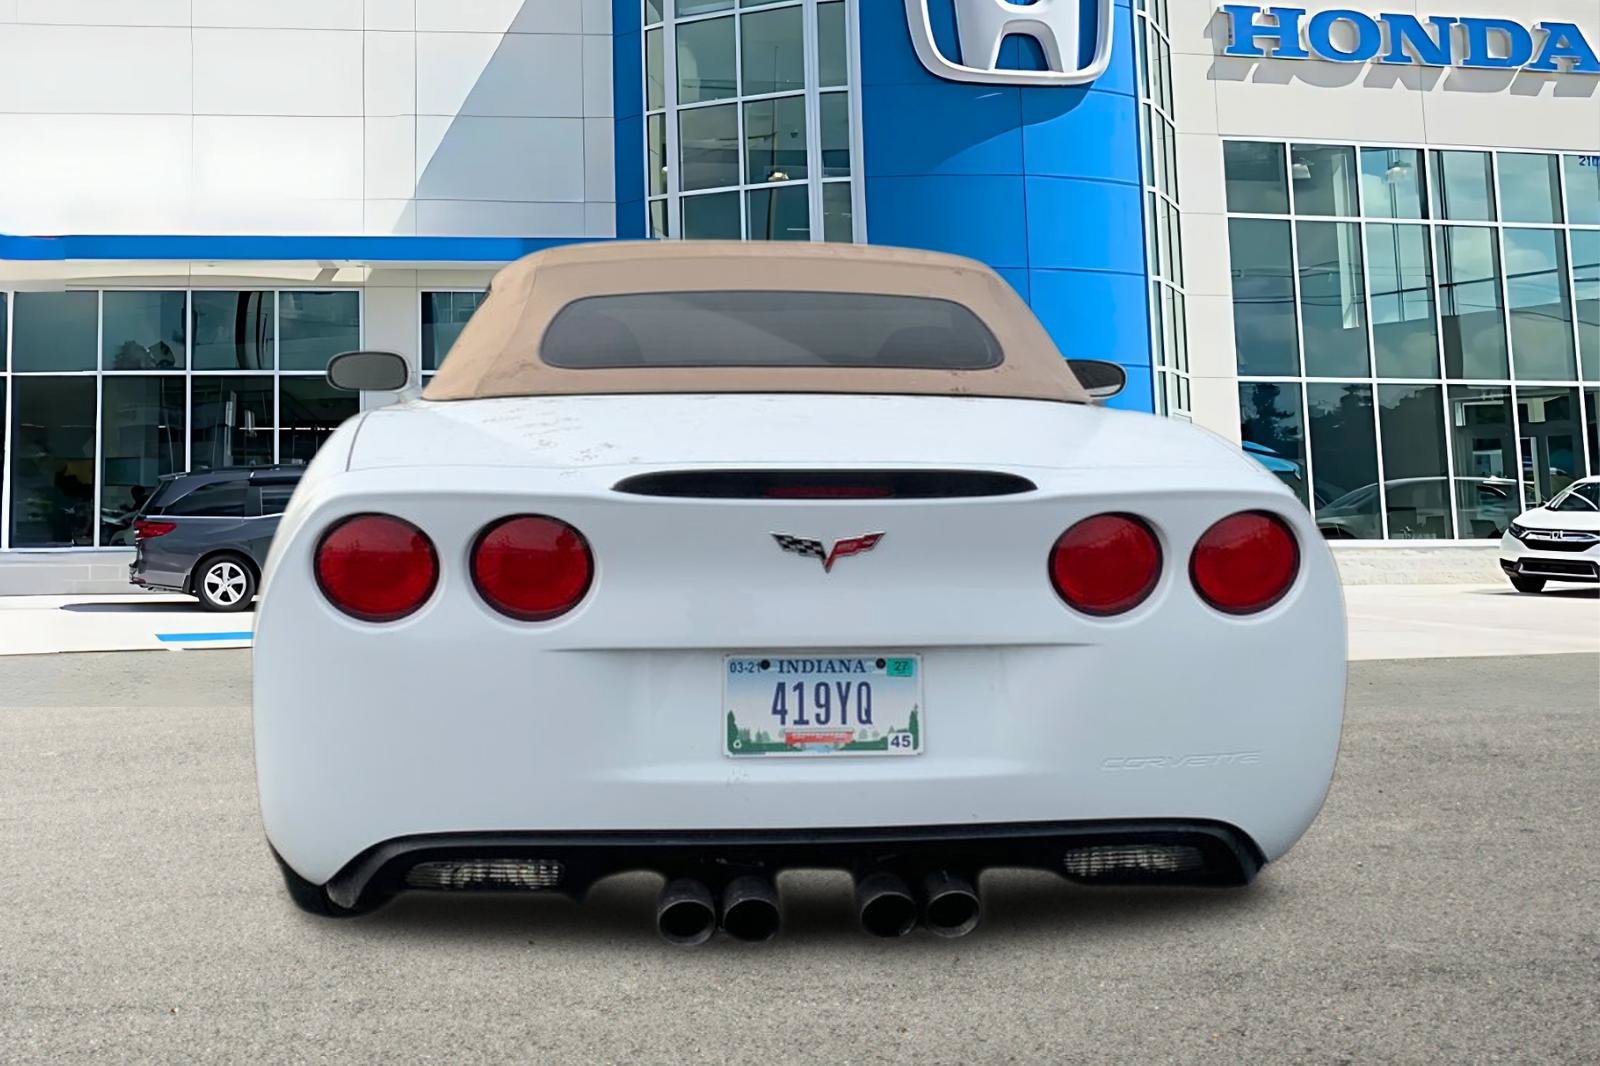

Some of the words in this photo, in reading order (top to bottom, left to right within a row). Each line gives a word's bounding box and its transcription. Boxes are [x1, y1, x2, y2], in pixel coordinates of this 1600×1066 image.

[1222, 4, 1600, 73] HONDA
[777, 659, 866, 674] INDIANA
[771, 681, 873, 726] 419YQ
[890, 735, 911, 748] 45
[1100, 751, 1264, 771] CORVETTE
